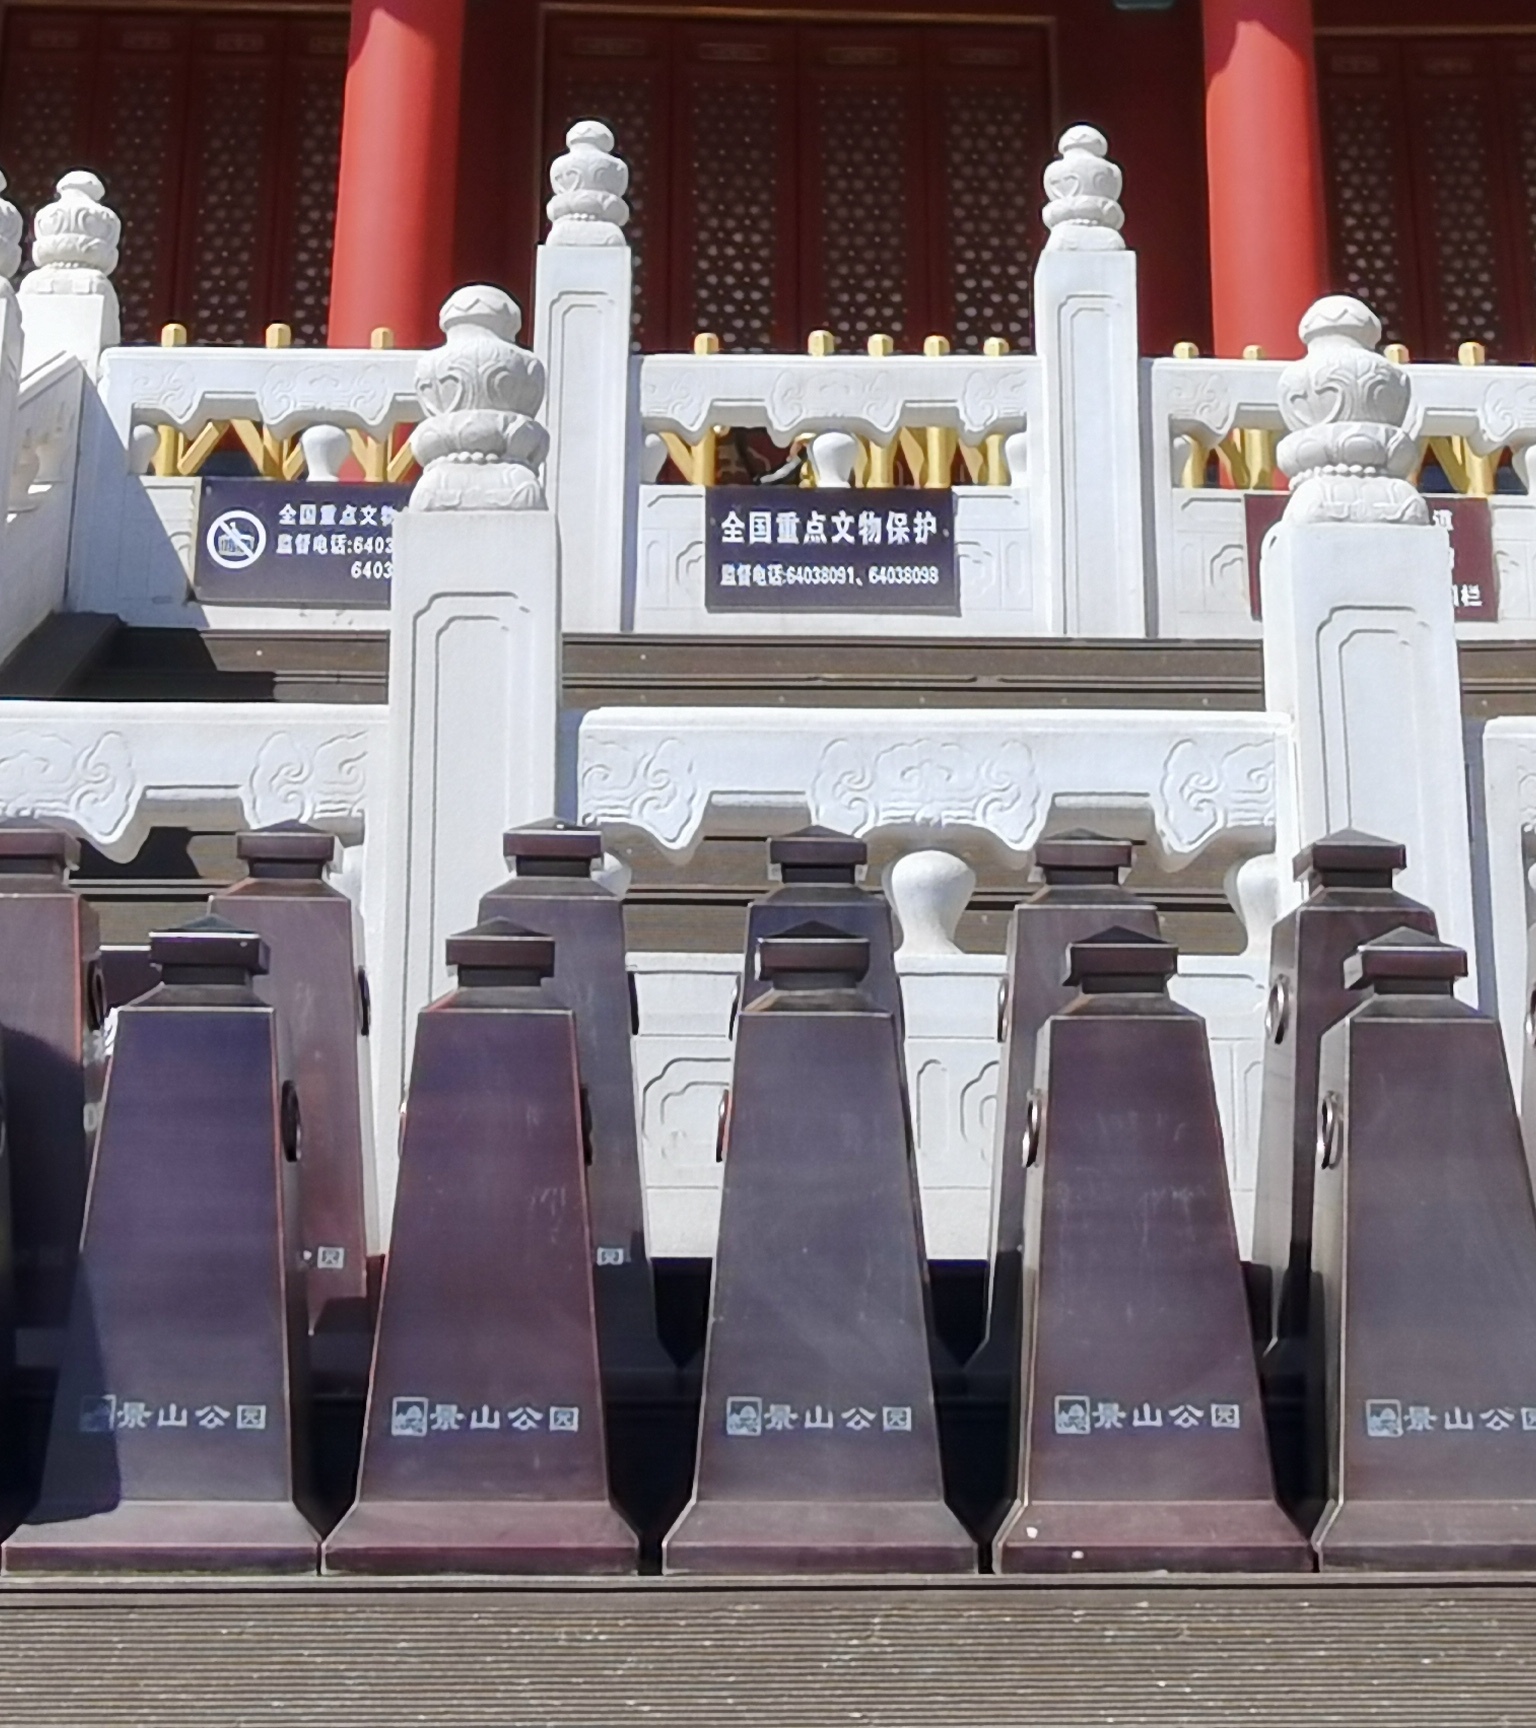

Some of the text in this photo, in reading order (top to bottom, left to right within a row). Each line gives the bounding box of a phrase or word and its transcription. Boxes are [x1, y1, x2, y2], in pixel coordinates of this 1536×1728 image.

[721, 510, 938, 545] 全国重点文物保护
[117, 1402, 267, 1430] 景山公园
[429, 1403, 580, 1432] 景山公园
[763, 1404, 912, 1432] 景山公园
[1092, 1402, 1240, 1430] 景山公园
